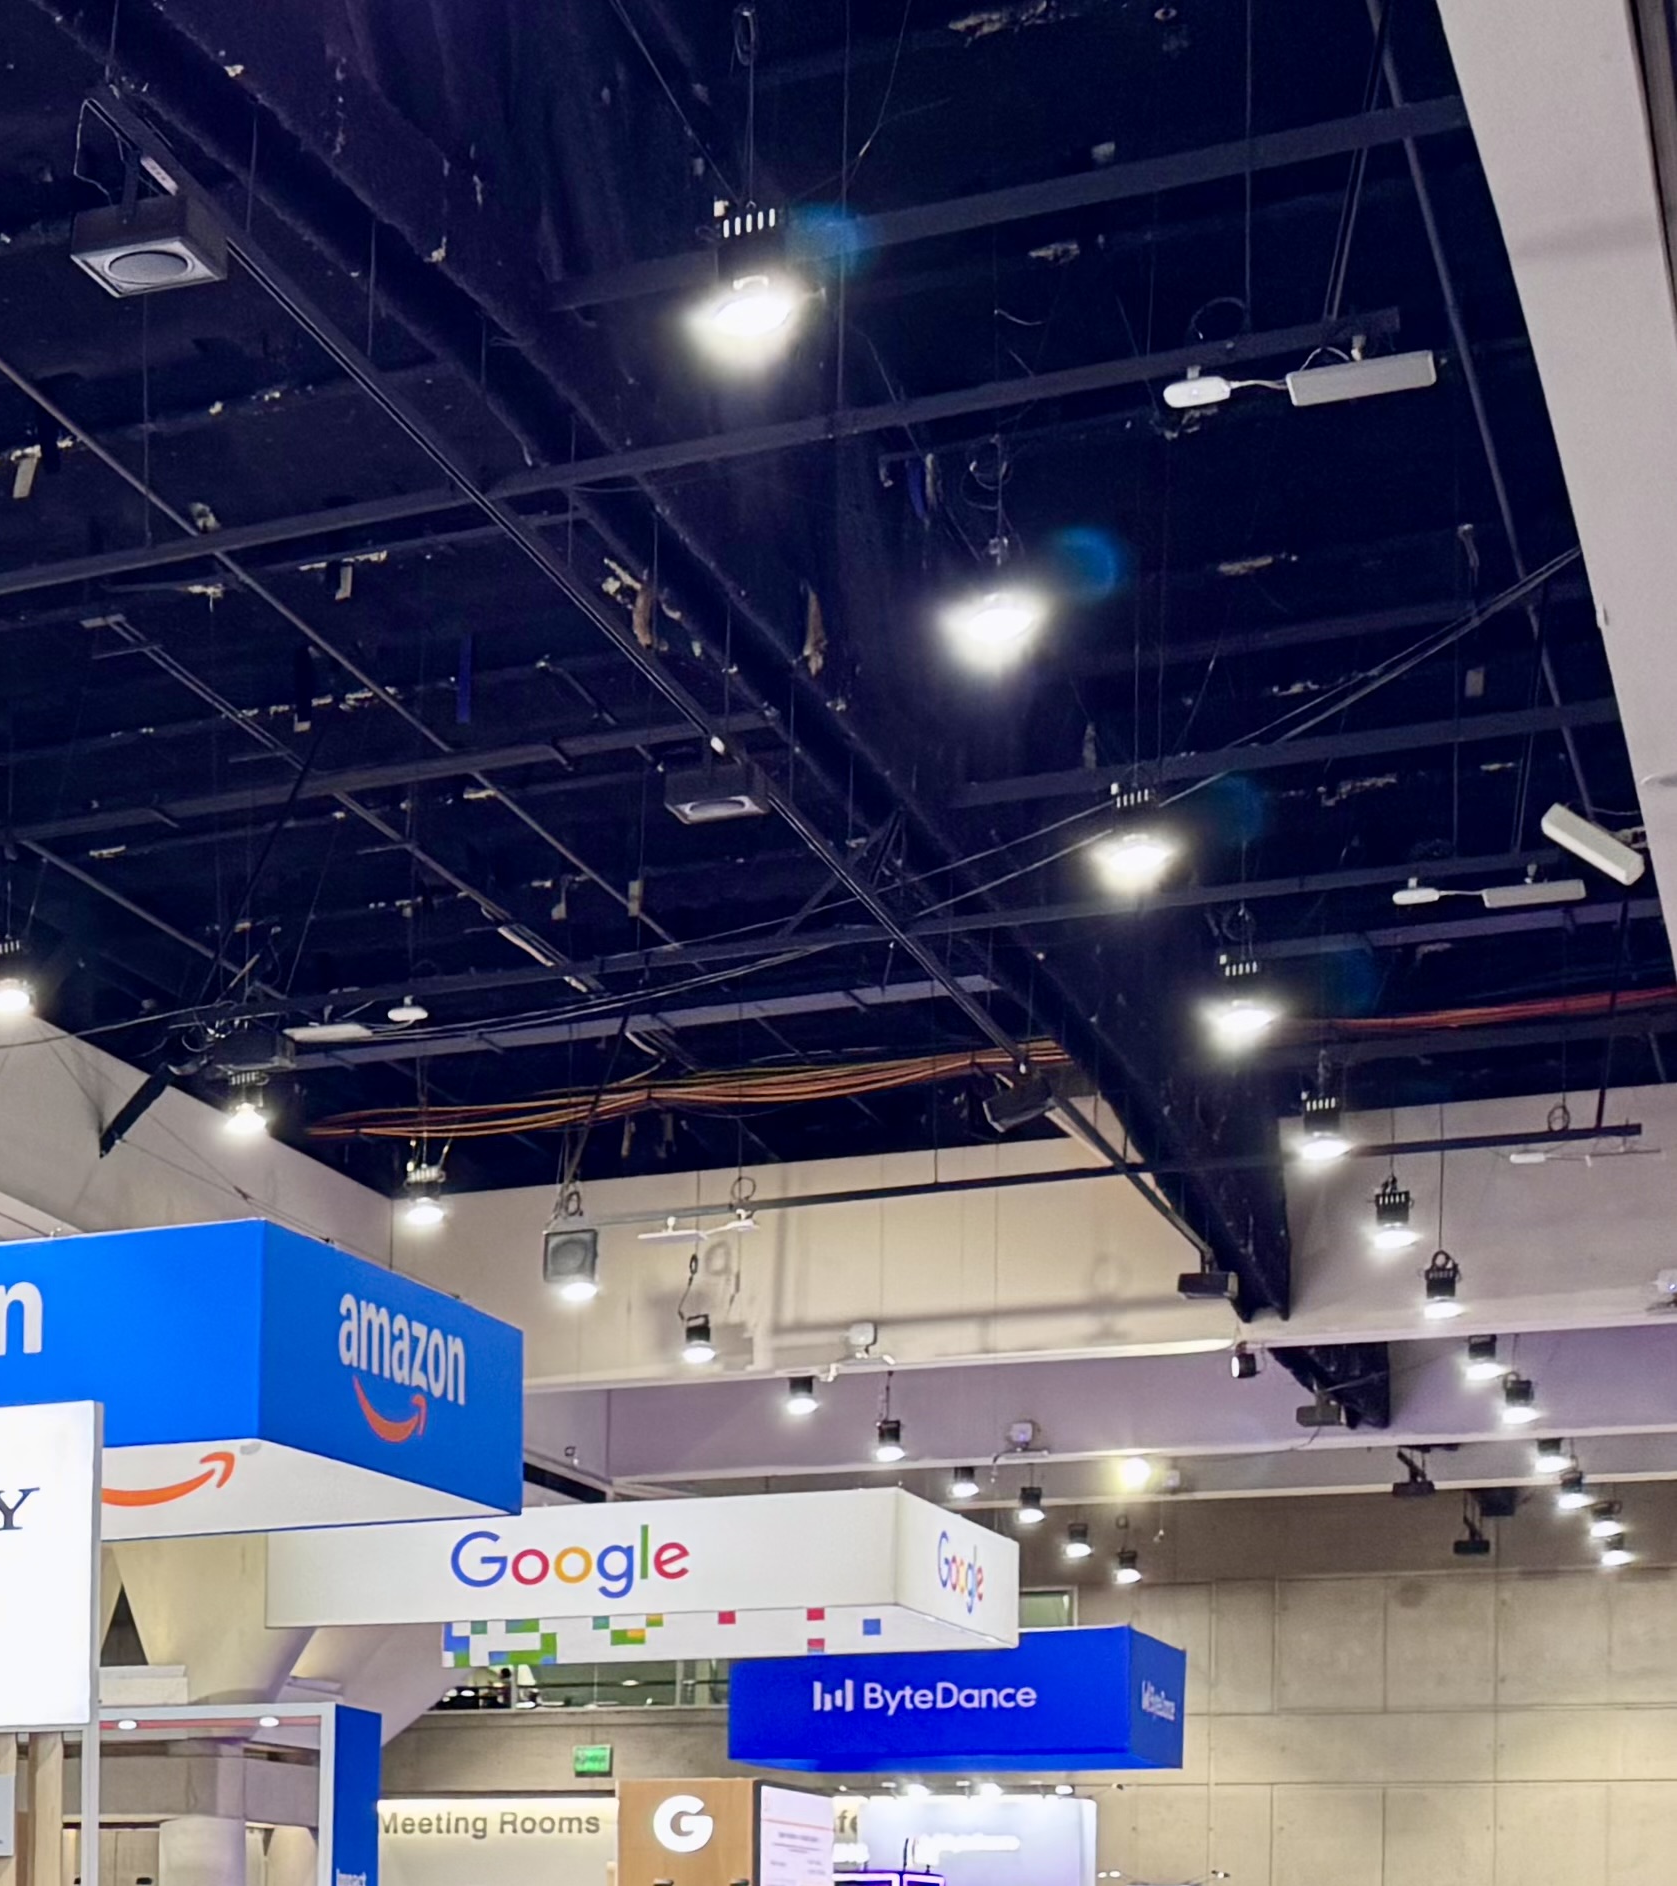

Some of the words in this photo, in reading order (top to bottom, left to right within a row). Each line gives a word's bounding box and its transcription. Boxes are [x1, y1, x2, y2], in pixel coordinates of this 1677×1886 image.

[338, 1293, 466, 1406] amazon
[450, 1524, 690, 1599] Google
[937, 1530, 984, 1614] Google
[863, 1680, 1038, 1715] ByteDance
[379, 1812, 487, 1839] Meeting
[499, 1812, 601, 1835] Rooms
